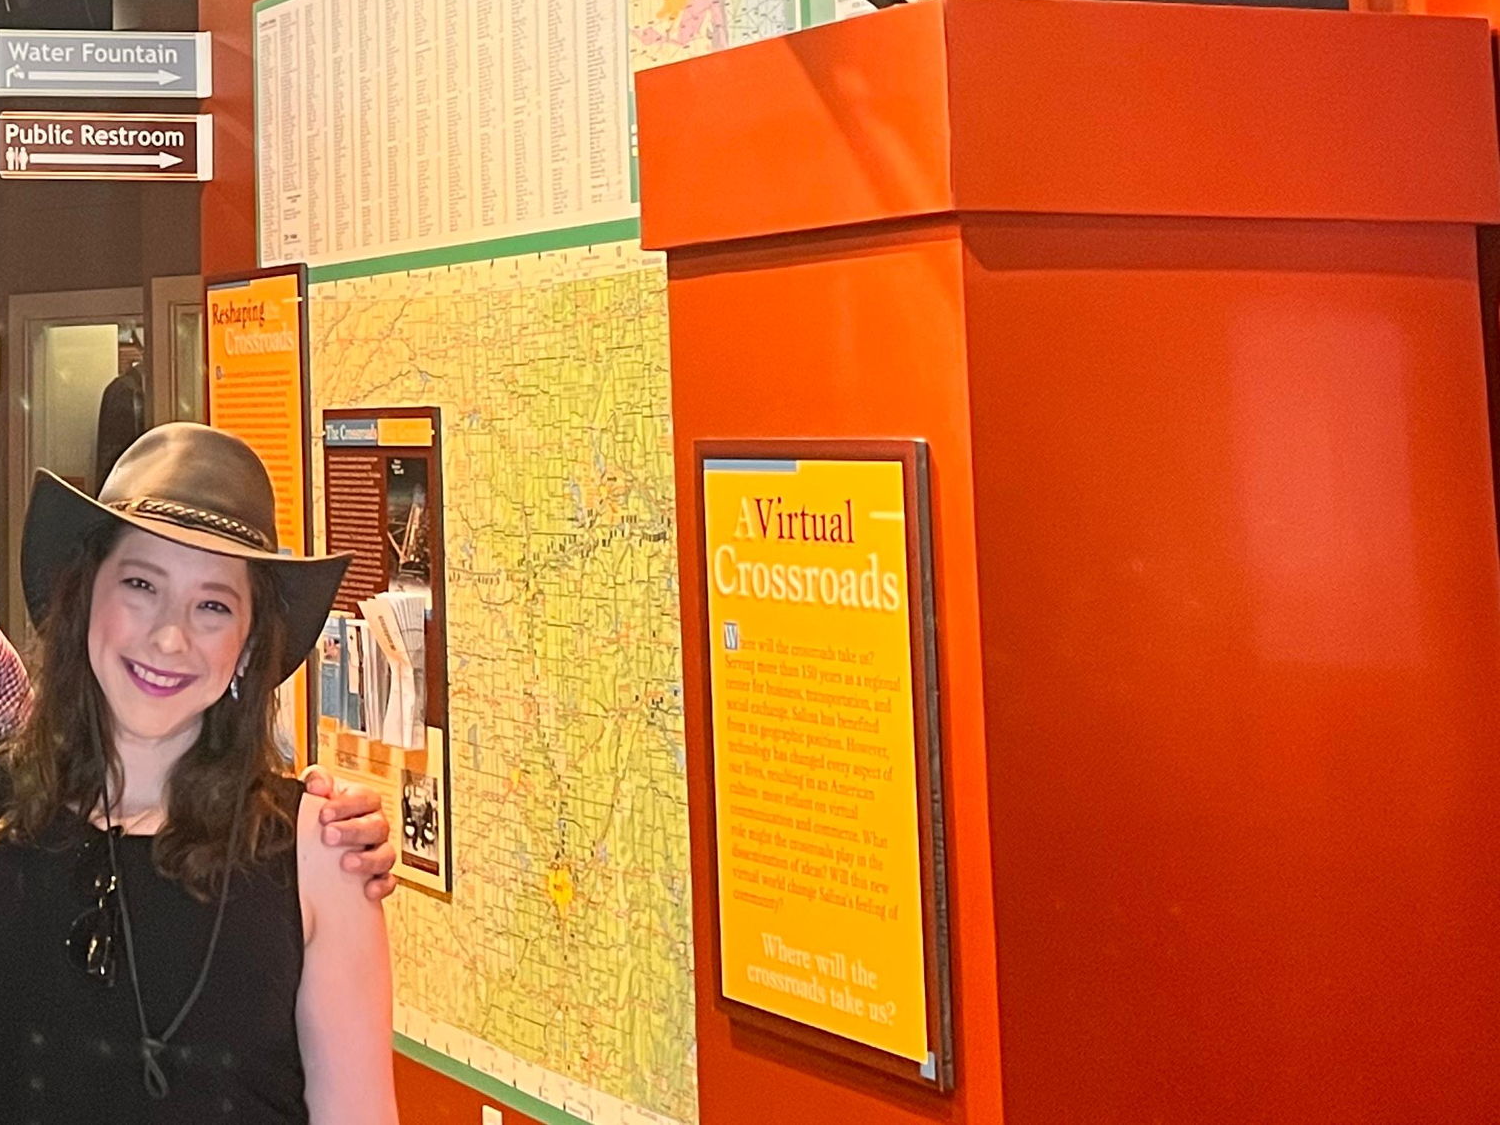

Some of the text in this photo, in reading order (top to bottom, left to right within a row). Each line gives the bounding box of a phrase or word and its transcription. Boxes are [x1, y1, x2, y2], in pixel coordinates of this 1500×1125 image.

[8, 42, 178, 64] Water Fountain
[5, 124, 185, 147] Public Restroom
[211, 299, 266, 329] Reshaping
[224, 323, 295, 355] Crossroads
[732, 496, 855, 544] A Virtual
[713, 544, 901, 612] Crossroads
[760, 931, 878, 990] Where will the
[746, 963, 897, 1026] crossroads take us?
